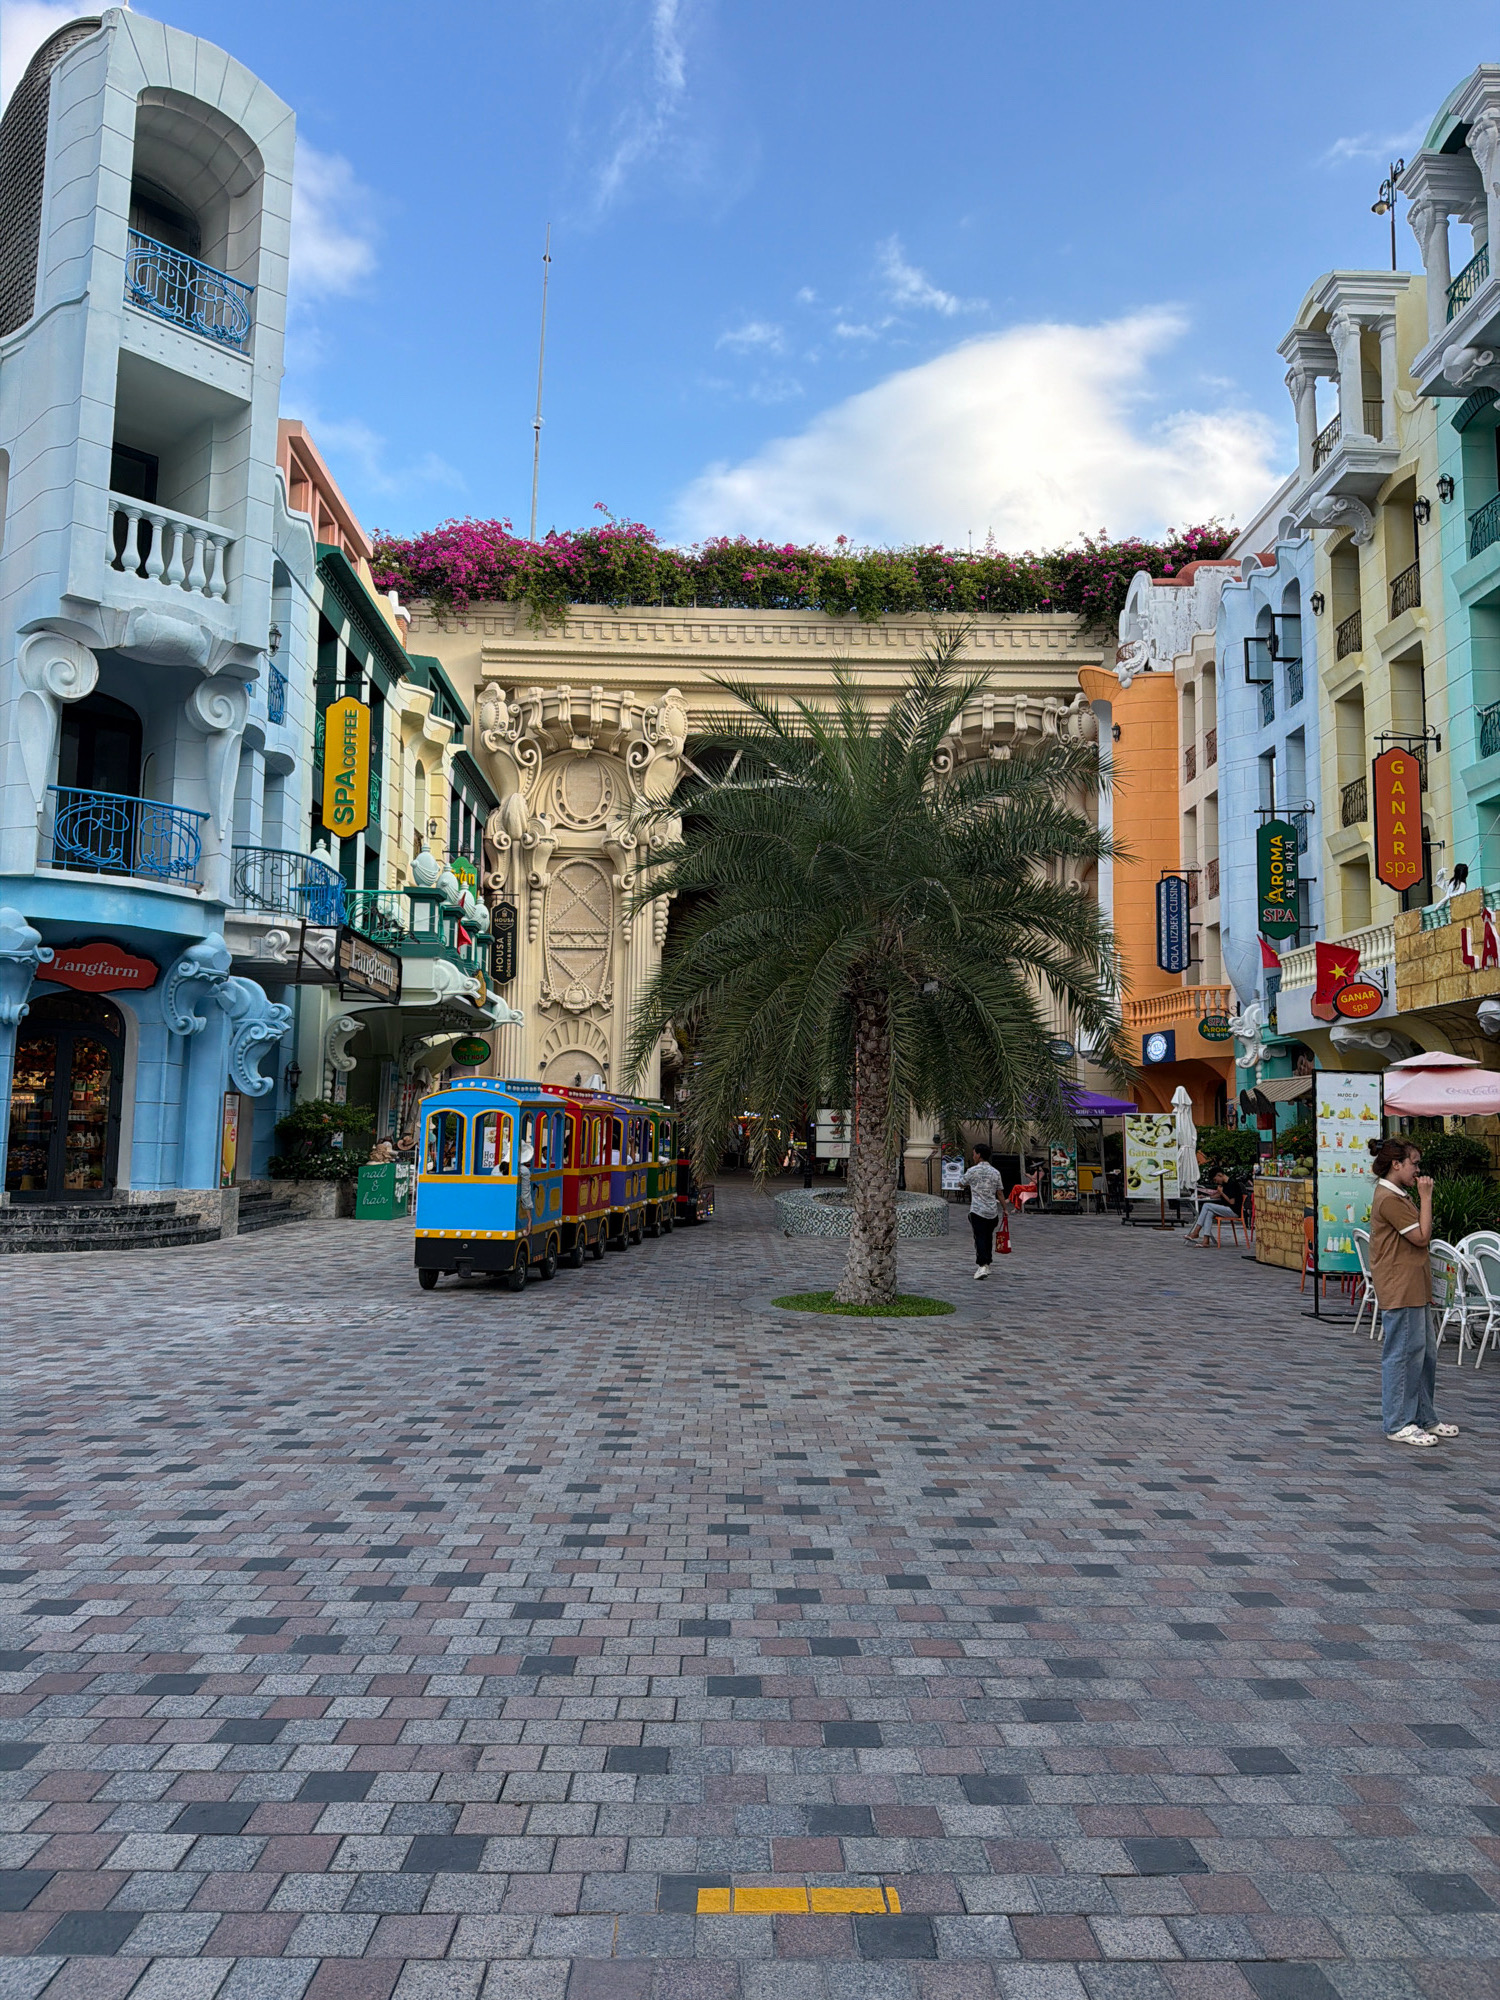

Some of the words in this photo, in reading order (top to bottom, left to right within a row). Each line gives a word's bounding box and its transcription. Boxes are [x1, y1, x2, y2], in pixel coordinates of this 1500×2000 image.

[343, 709, 358, 768] COFFEE
[333, 769, 356, 825] SPA
[1390, 760, 1406, 855] GANAR
[1285, 841, 1296, 872] 마사지
[1268, 835, 1284, 904] AROMA
[1385, 861, 1416, 877] spa
[1169, 879, 1178, 913] CUISINE
[1286, 878, 1296, 899] 치료
[1263, 908, 1297, 922] SPA
[350, 940, 394, 987] Langfarm
[496, 937, 504, 972] HOUSA
[1170, 944, 1179, 970] PIOLA
[53, 957, 139, 978] Langfarm
[1341, 990, 1376, 1003] GANAR
[1352, 1003, 1369, 1013] spa
[1203, 1023, 1230, 1033] AROM
[1207, 1017, 1228, 1027] SPA
[1128, 1148, 1158, 1157] Ganar
[362, 1164, 388, 1178] nail
[362, 1191, 389, 1205] hair
